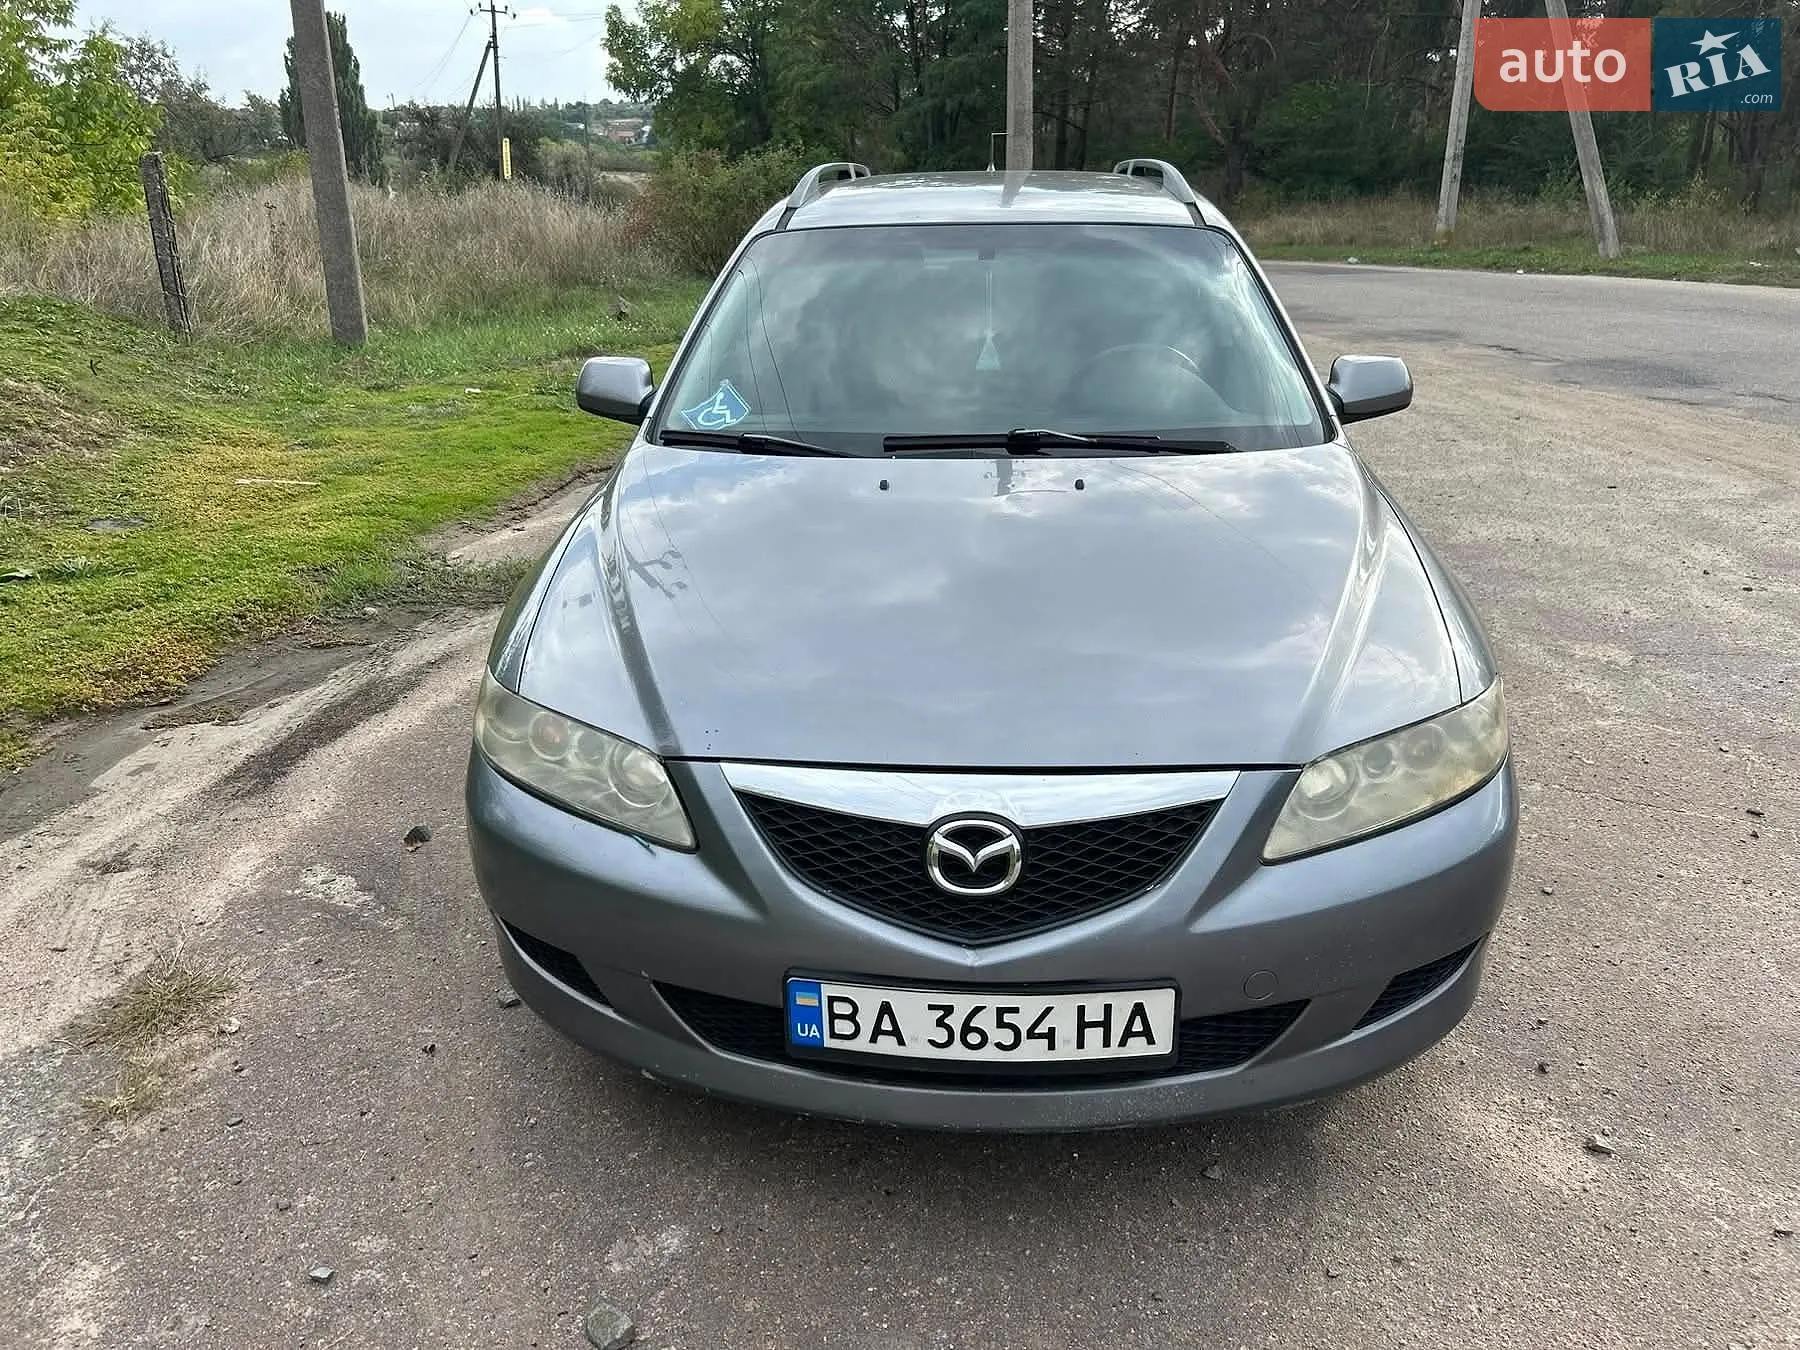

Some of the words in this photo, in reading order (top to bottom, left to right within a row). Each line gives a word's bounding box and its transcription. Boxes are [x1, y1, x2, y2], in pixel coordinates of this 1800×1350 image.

[797, 1023, 820, 1039] UA
[826, 994, 907, 1047] BA
[926, 1003, 1056, 1051] 3654
[1076, 1001, 1156, 1050] HA
